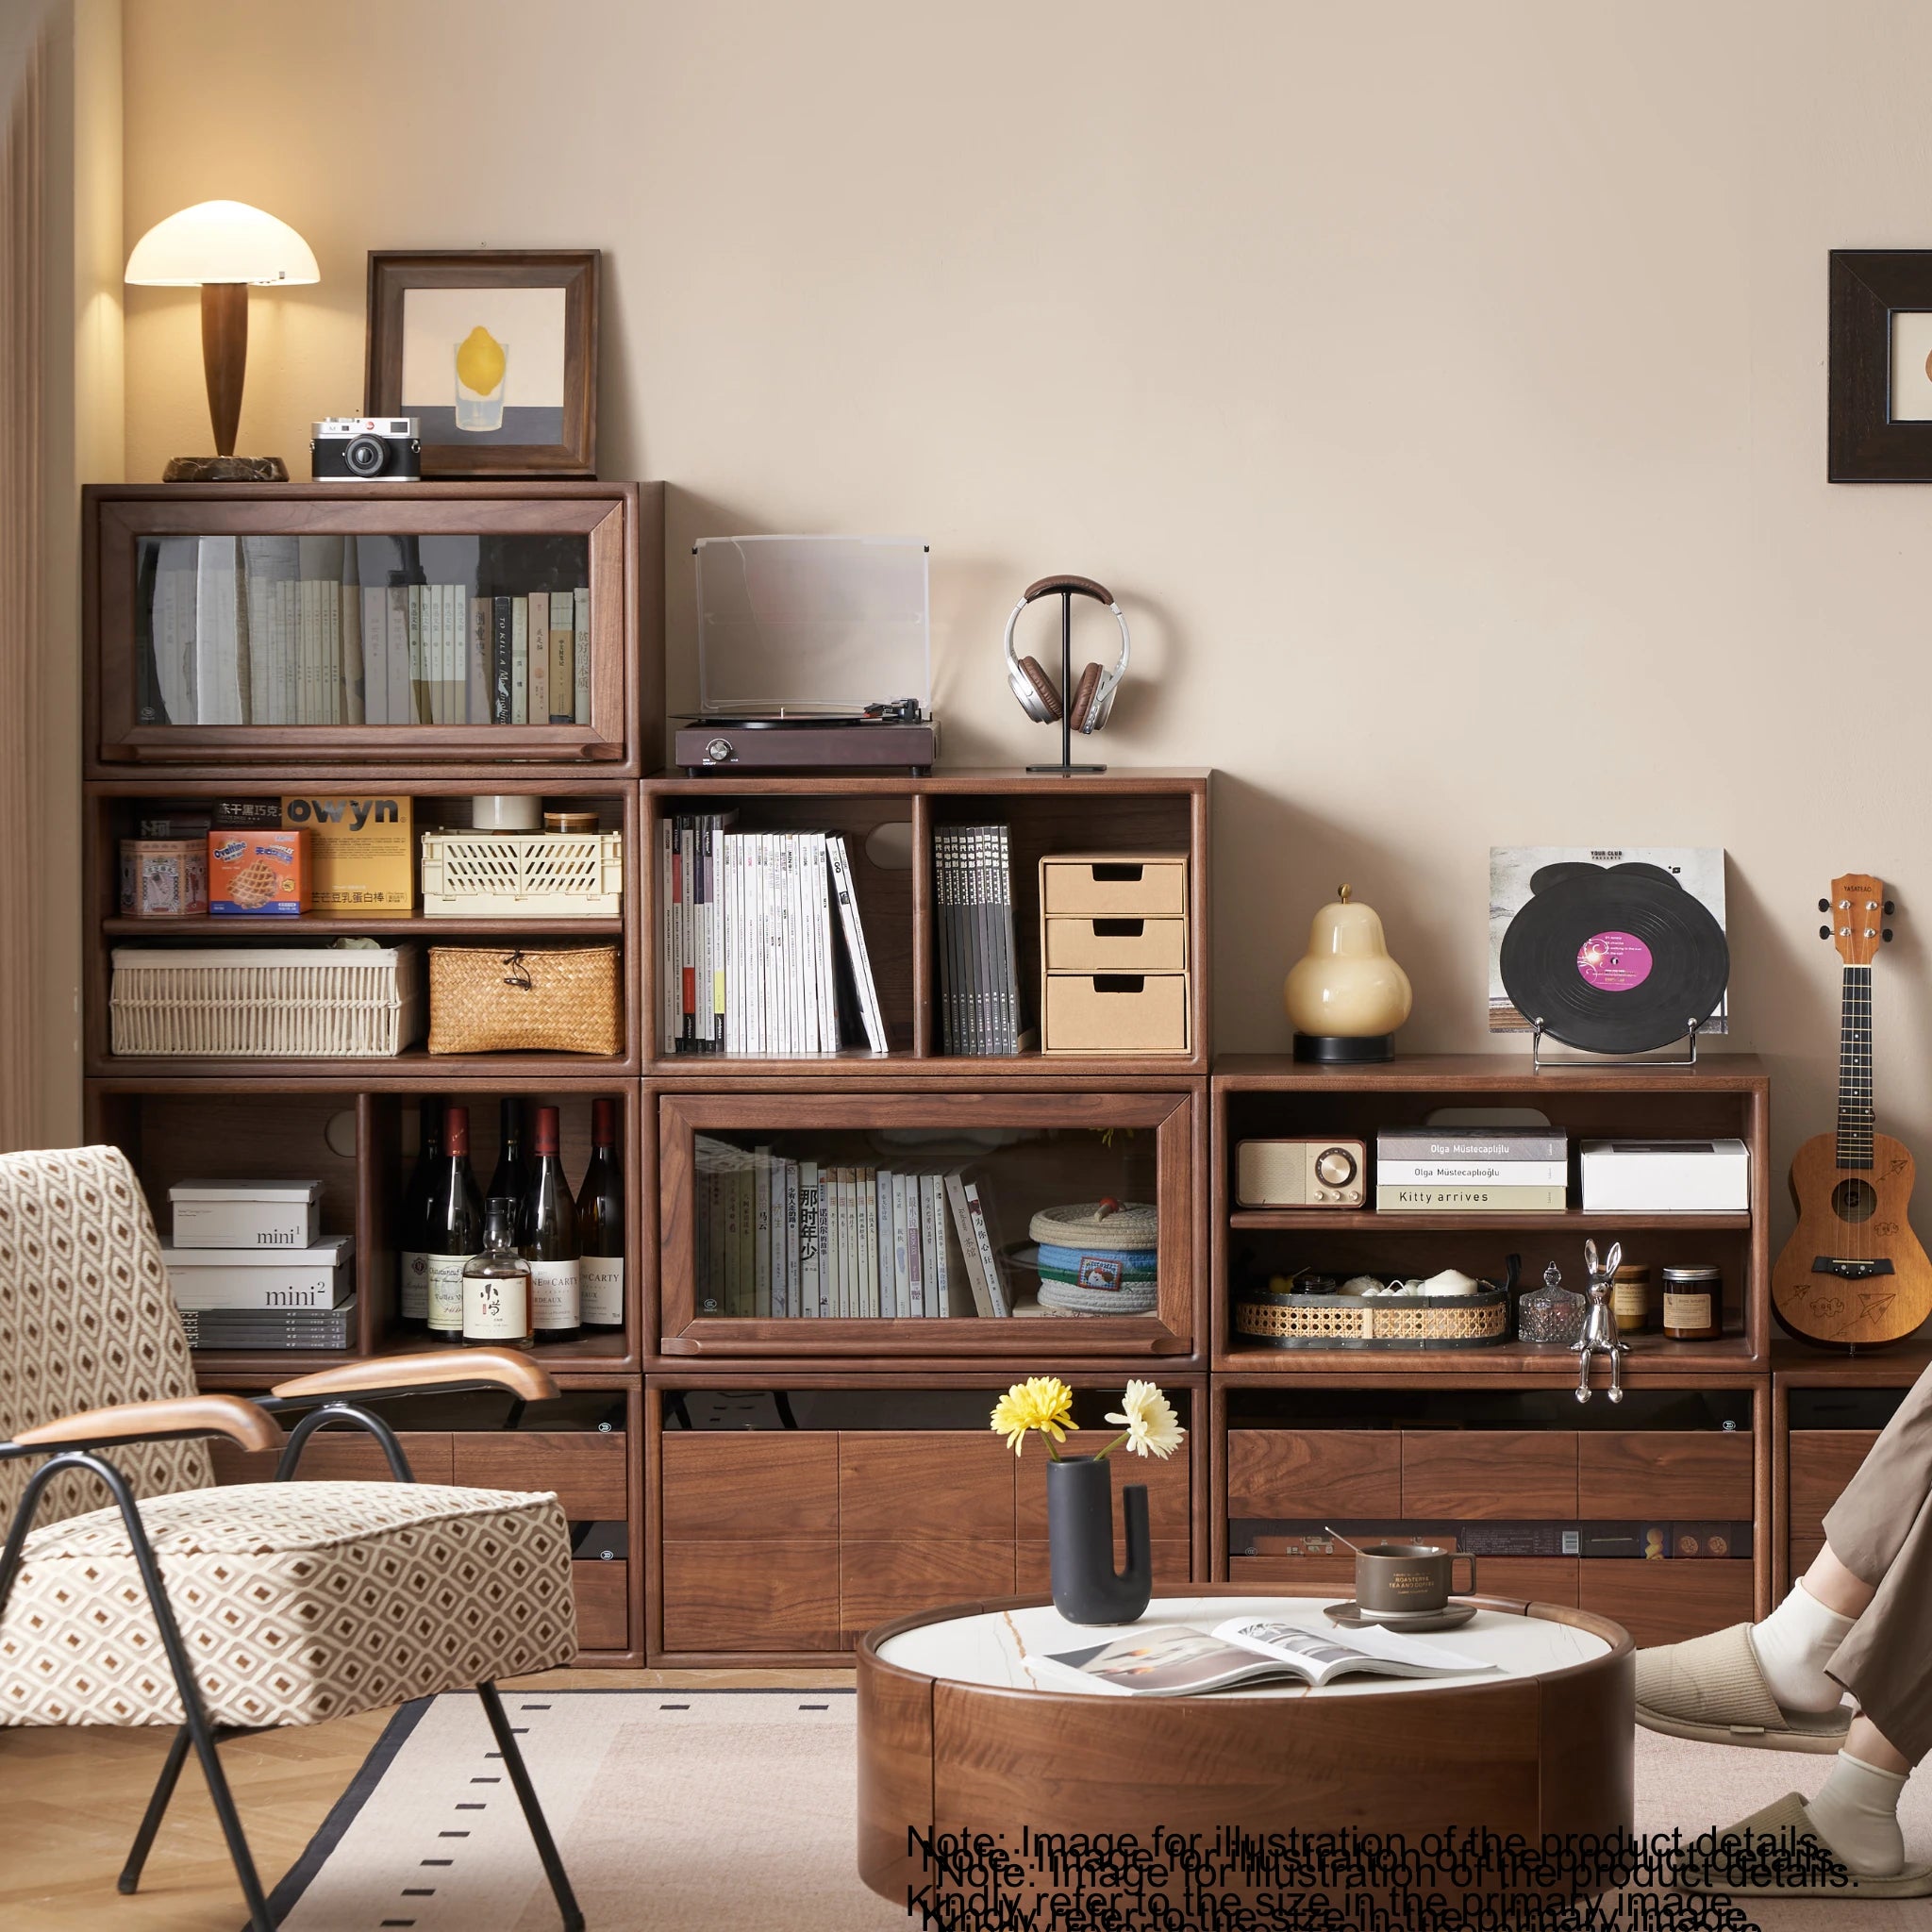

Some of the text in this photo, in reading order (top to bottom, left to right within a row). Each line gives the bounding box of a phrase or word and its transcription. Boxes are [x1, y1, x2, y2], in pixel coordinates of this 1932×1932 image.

[499, 618, 506, 629] TO
[219, 803, 280, 817] 冻干黑巧克
[288, 799, 399, 831] owyn
[214, 842, 246, 858] Ovaltine
[1431, 1144, 1450, 1154] Olga
[1414, 1168, 1433, 1177] Olga
[1399, 1191, 1489, 1204] Kitty arrives
[800, 1189, 818, 1262] 那时年少
[820, 1208, 828, 1256] 诺贝尔的故事
[588, 1274, 620, 1282] CARTY
